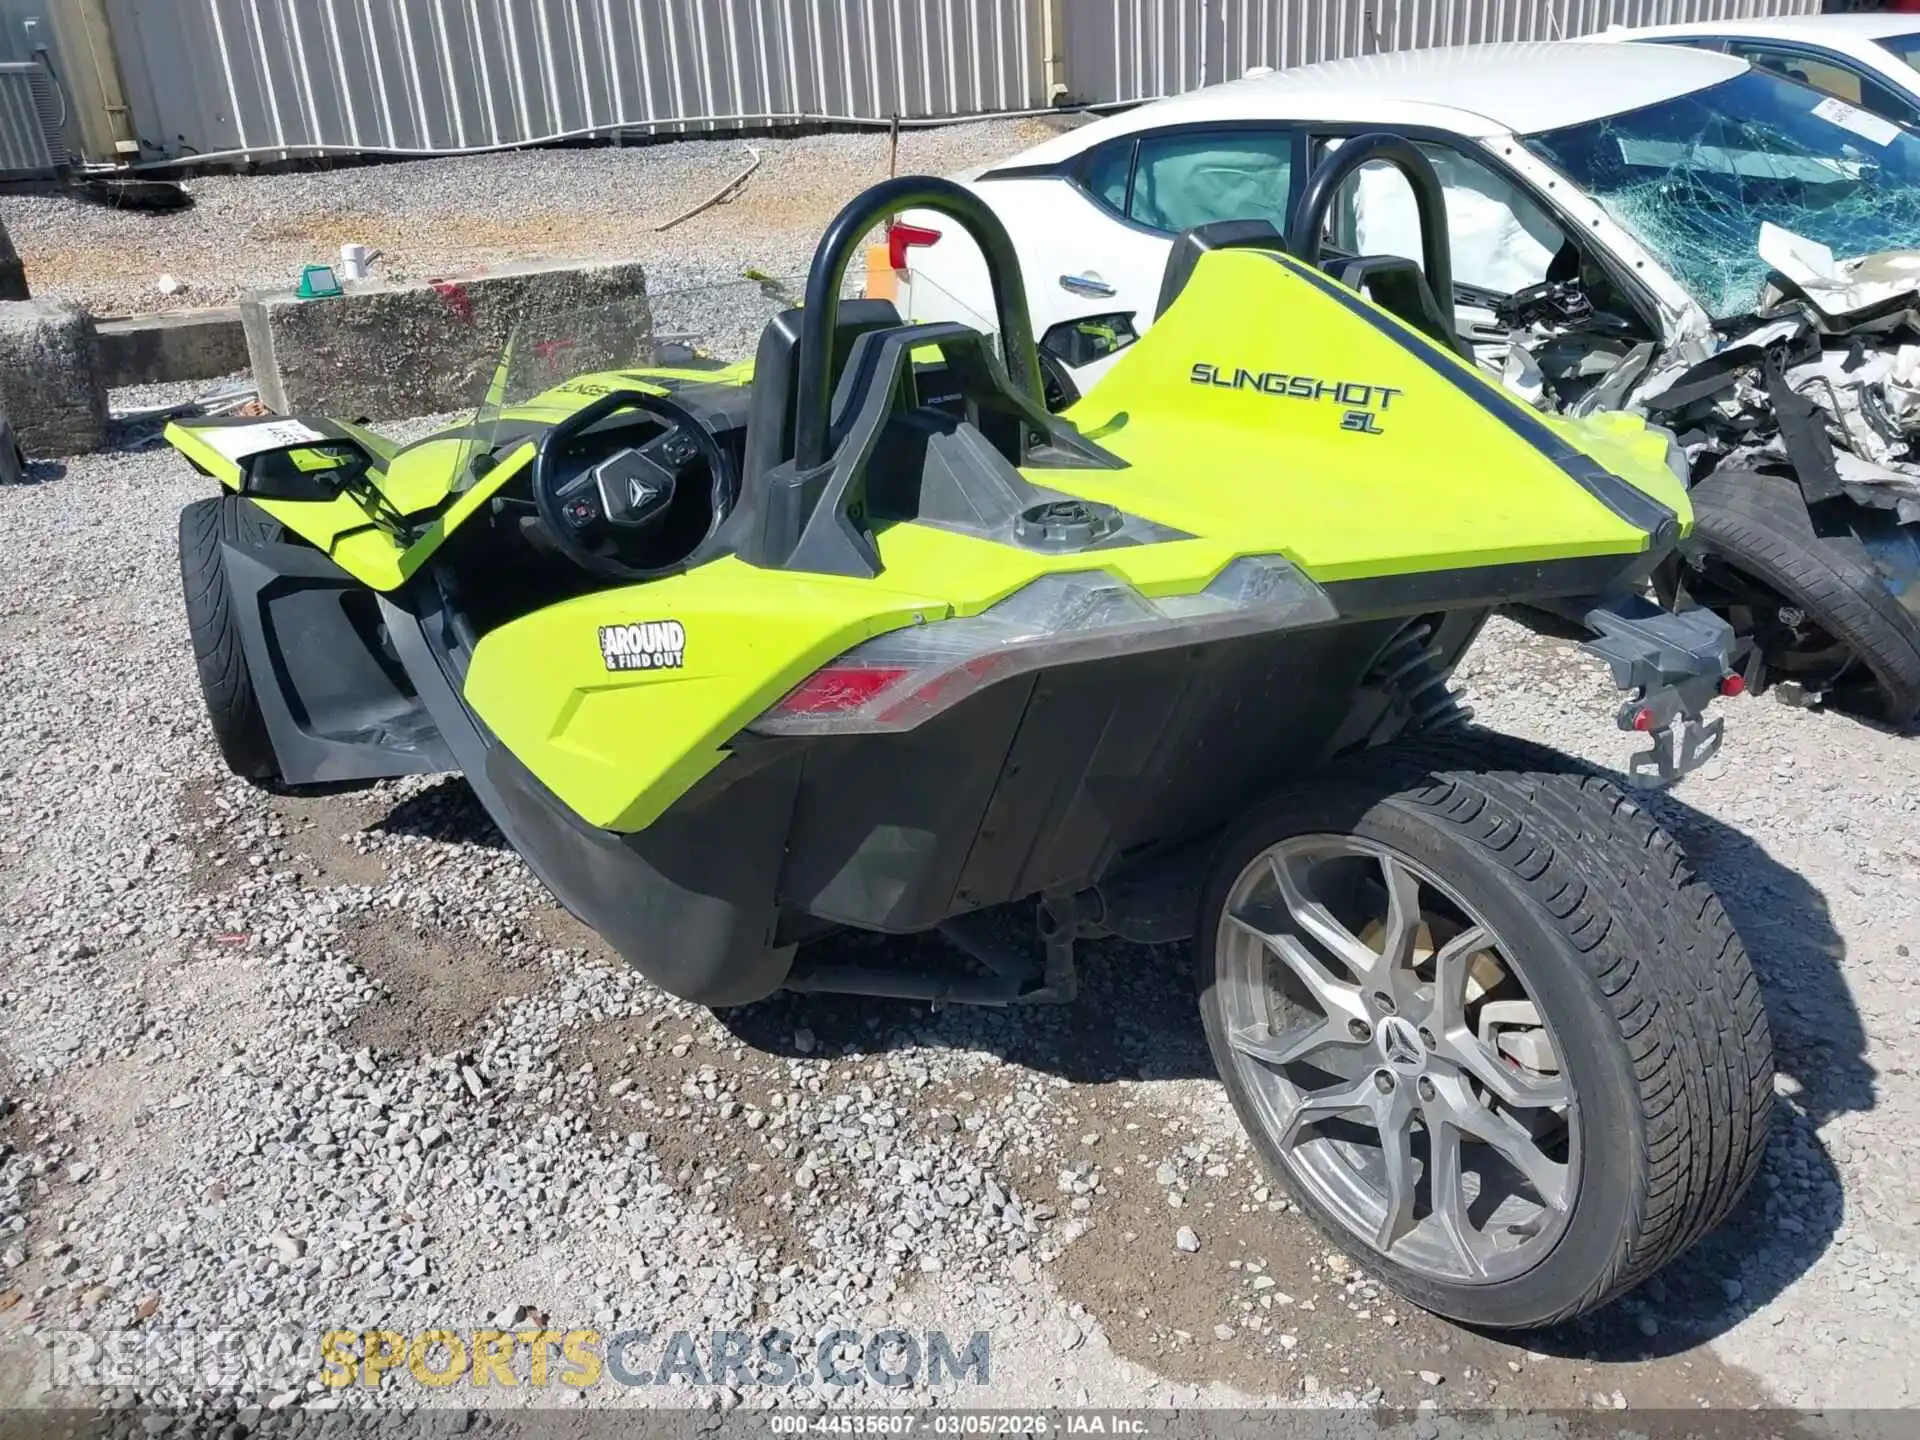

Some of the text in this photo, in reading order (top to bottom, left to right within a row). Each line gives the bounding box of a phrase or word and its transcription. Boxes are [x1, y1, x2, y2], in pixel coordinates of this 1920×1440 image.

[1190, 362, 1404, 410] SLINGSHOT
[1340, 410, 1384, 435] SL
[604, 620, 685, 656] AROUND
[618, 653, 652, 669] FIND
[652, 651, 682, 667] OUT
